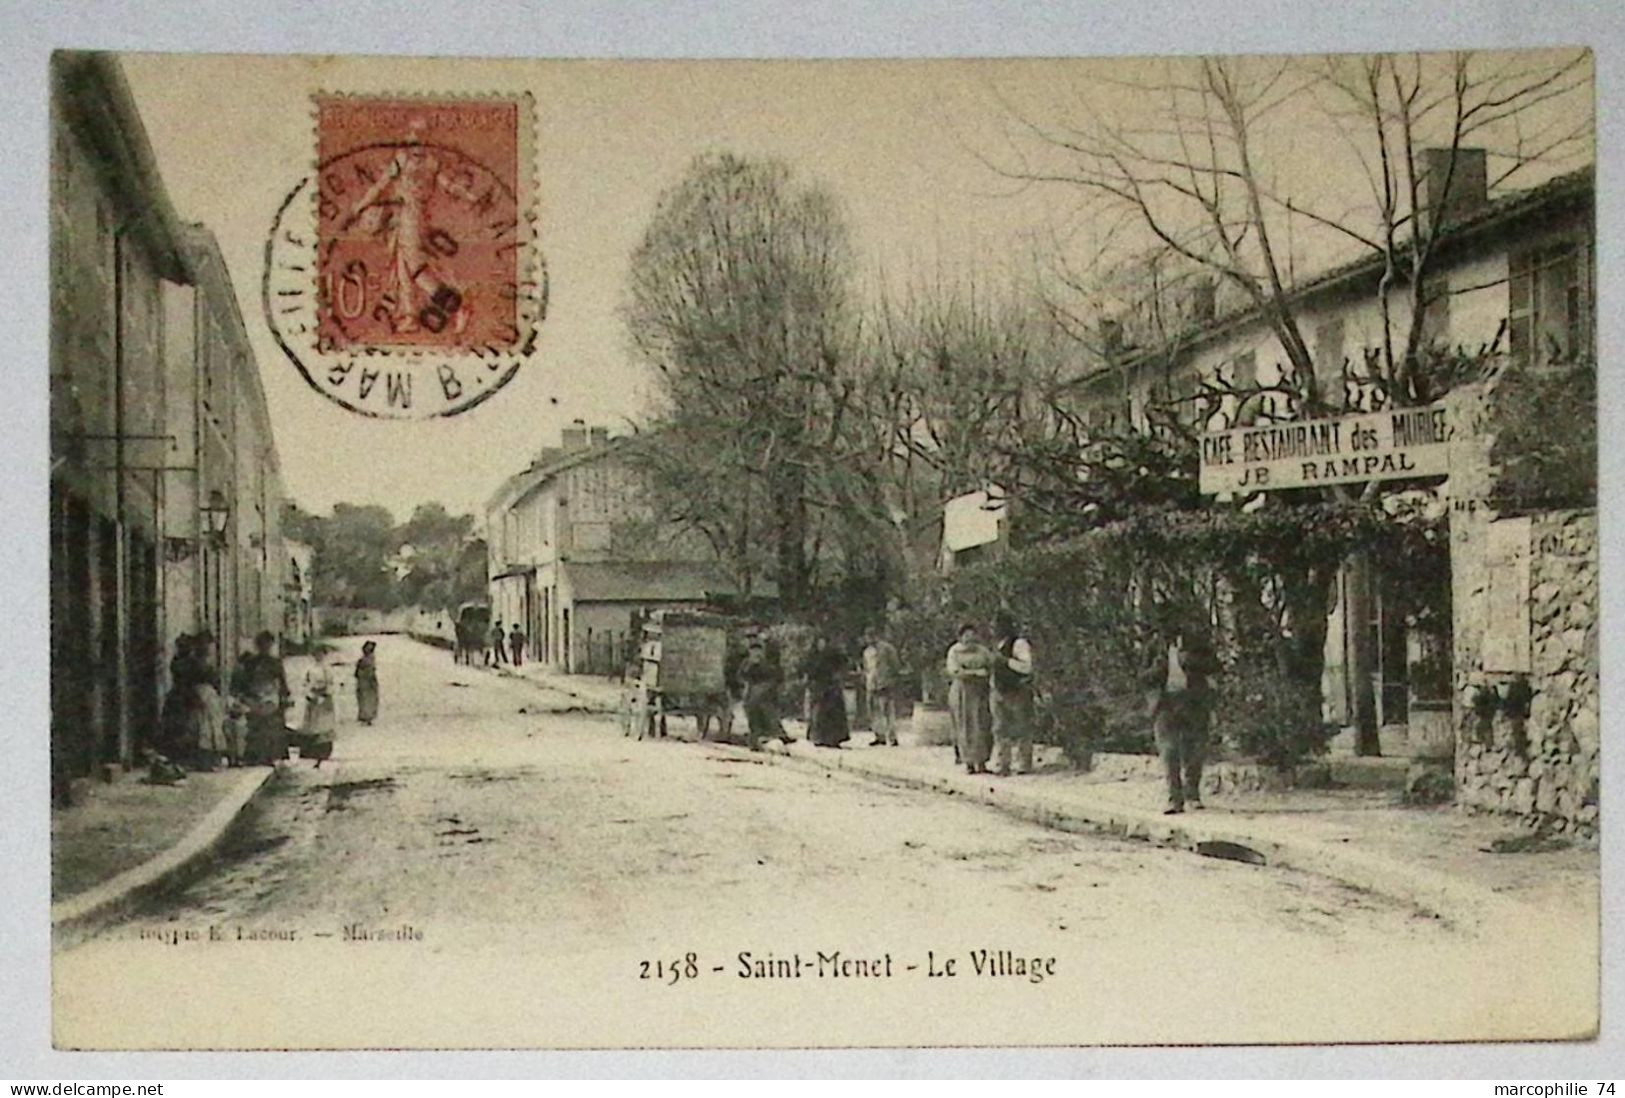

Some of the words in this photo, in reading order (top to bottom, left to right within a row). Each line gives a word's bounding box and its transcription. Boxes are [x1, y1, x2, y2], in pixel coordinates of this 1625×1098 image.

[1243, 422, 1341, 463] RESTAURANT
[1351, 422, 1378, 452] des
[1301, 452, 1416, 481] RAMPAL
[343, 924, 425, 942] Marseille
[639, 951, 699, 986] 2158
[738, 951, 893, 980] Saint-Menet
[928, 951, 957, 978] Le
[970, 949, 1057, 985] Village
